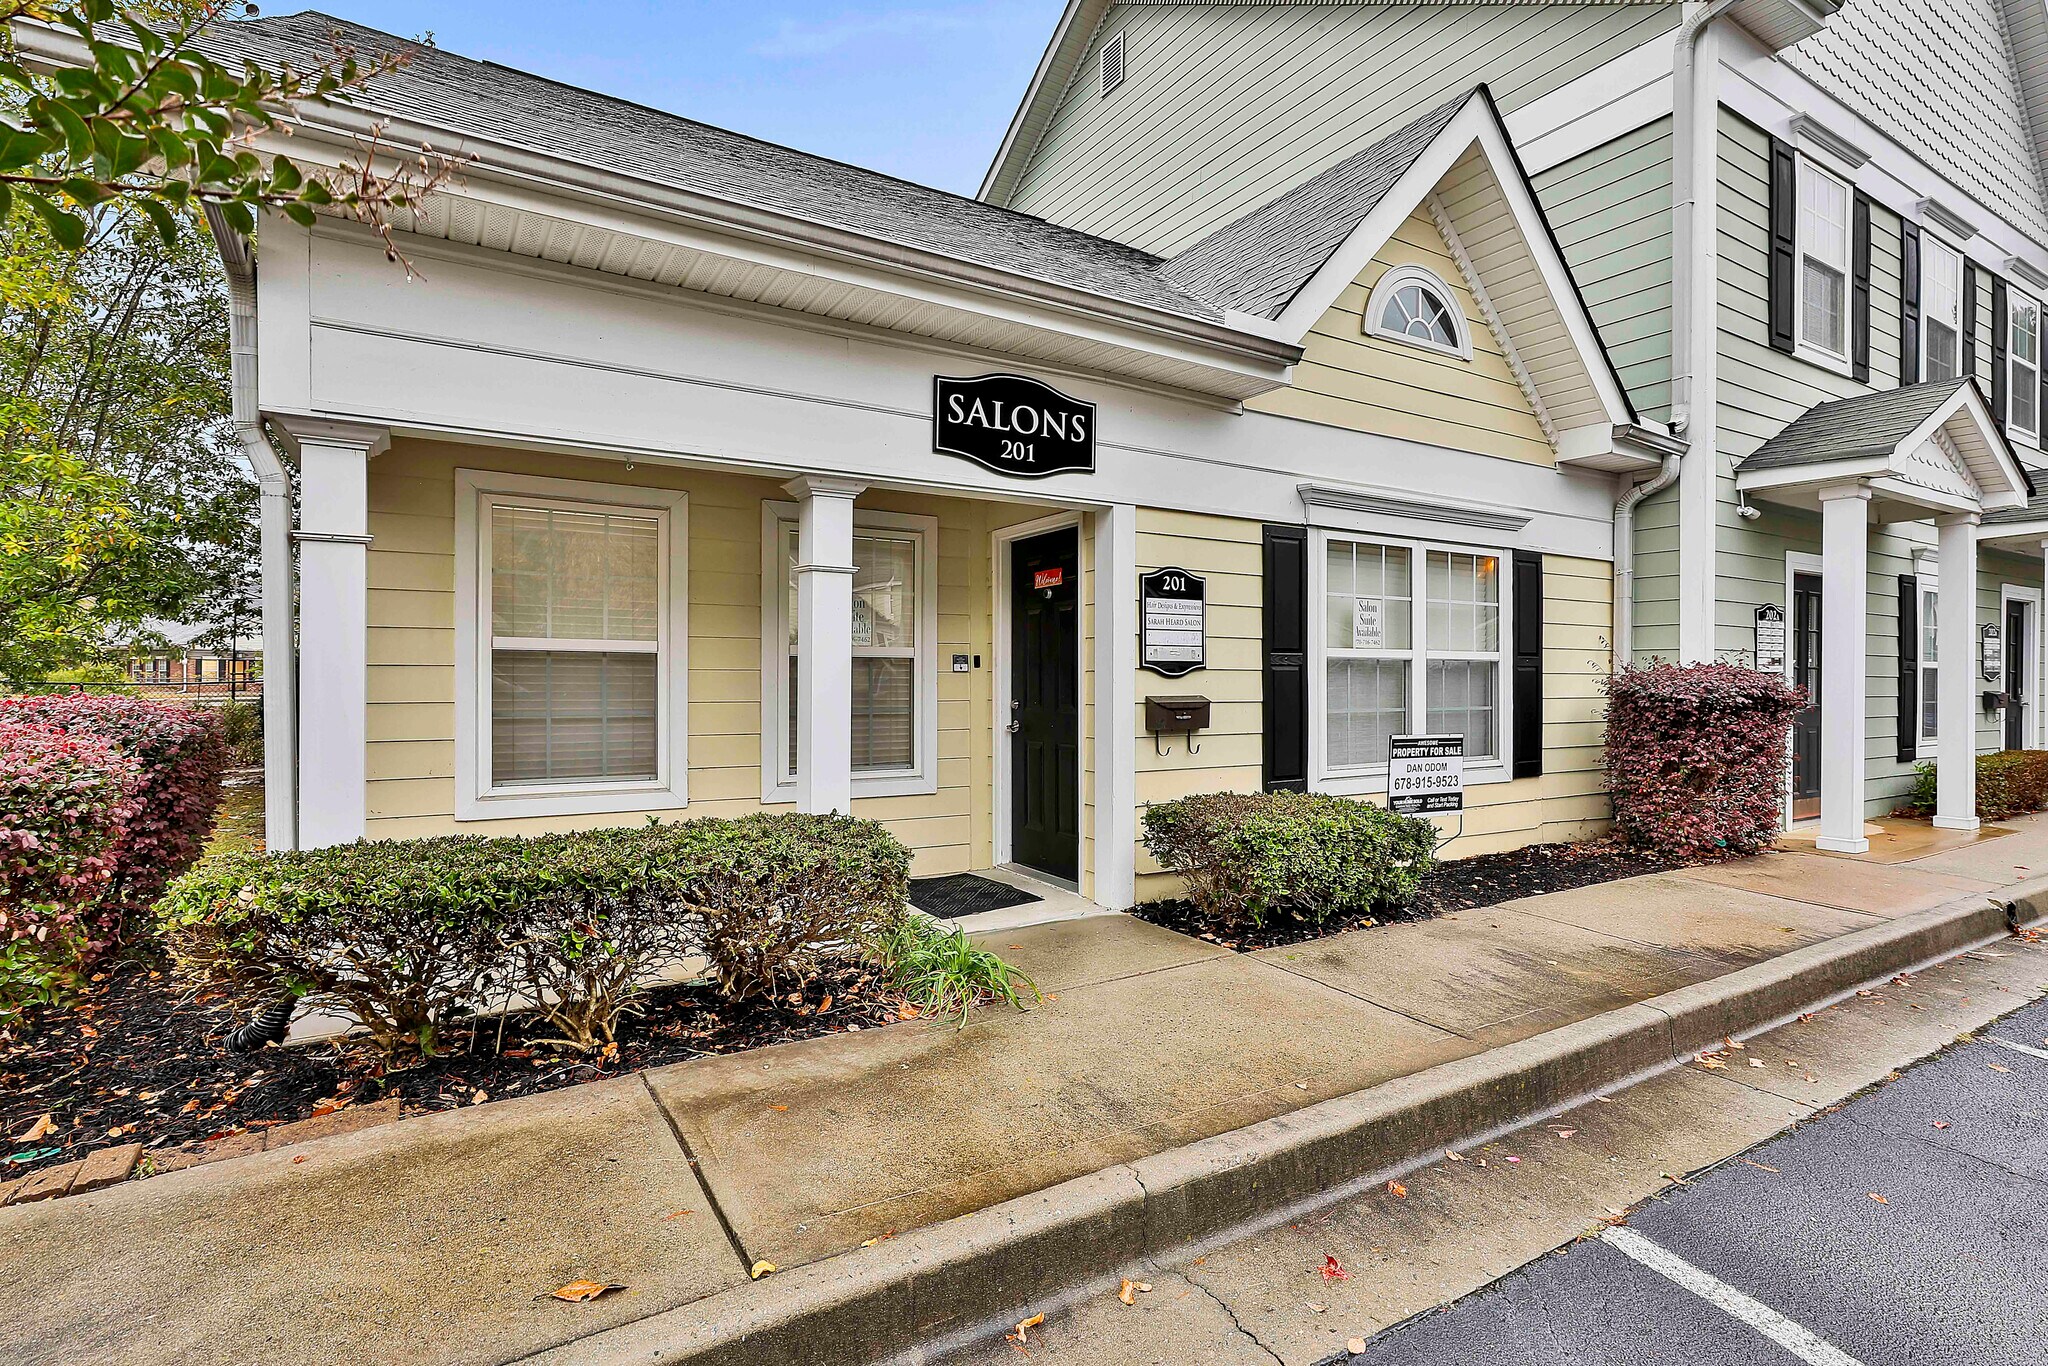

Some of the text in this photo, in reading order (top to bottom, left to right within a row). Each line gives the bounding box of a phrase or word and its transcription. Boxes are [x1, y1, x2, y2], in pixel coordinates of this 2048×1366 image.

[948, 393, 1085, 443] SALONS
[1000, 439, 1036, 463] 201
[1162, 576, 1186, 592] 201
[1359, 600, 1377, 613] Salon
[1166, 617, 1184, 626] HEARD
[1185, 618, 1201, 627] SALON
[1359, 613, 1377, 625] Suite
[1392, 746, 1462, 757] PROPERTY FOR SALE
[1406, 762, 1448, 773] DAN ODOM
[1394, 774, 1459, 790] 678-915-9523
